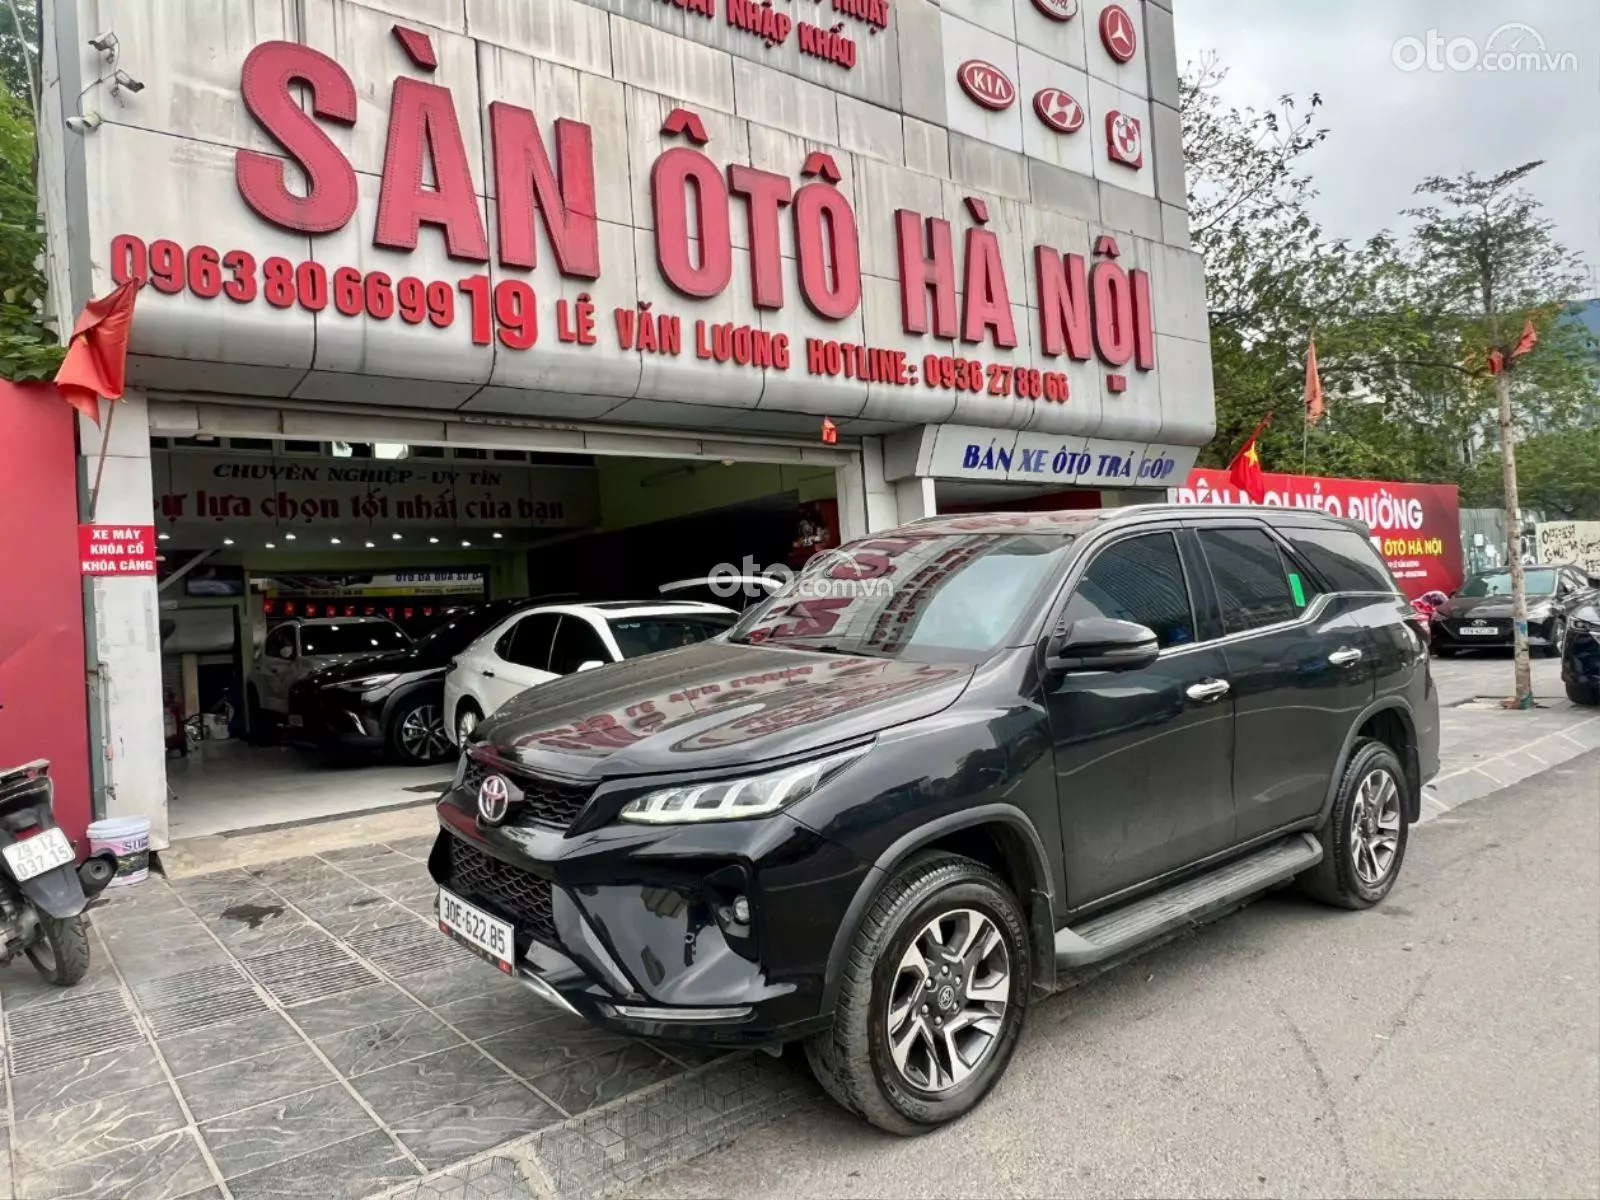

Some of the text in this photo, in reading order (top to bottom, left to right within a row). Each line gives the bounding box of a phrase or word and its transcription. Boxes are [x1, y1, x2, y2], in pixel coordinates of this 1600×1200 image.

[973, 69, 1007, 99] KIA
[235, 24, 1154, 393] SÀN ÔTÔ HÀ NỘI
[556, 292, 597, 345] LÊ
[614, 301, 681, 355] VĂN
[696, 320, 790, 370] LƯƠNG
[806, 338, 919, 386] HOTLINE:
[962, 438, 1012, 472] BÁN
[1018, 448, 1048, 473] XE
[1137, 451, 1175, 479] GÓP
[1348, 487, 1423, 530] ĐƯỜNG
[92, 527, 141, 540] XE MÁY
